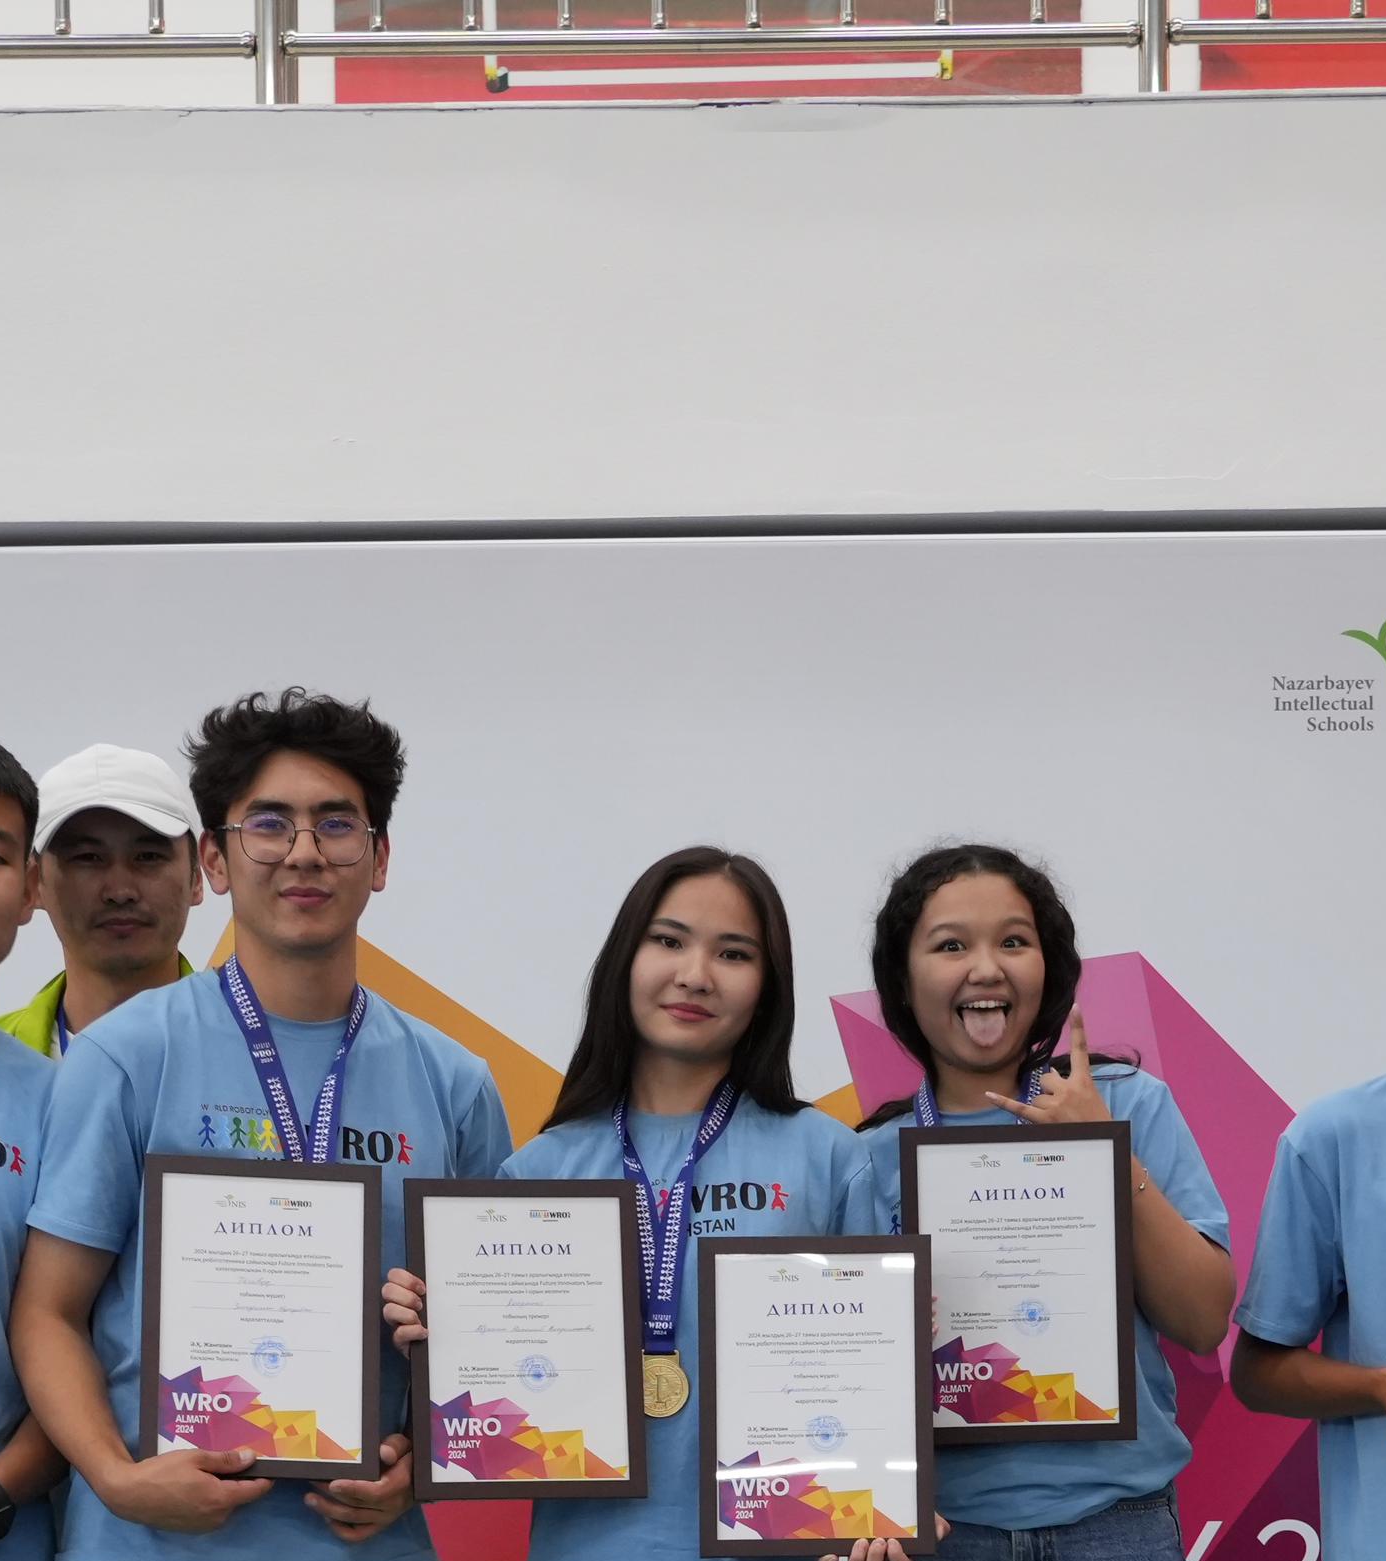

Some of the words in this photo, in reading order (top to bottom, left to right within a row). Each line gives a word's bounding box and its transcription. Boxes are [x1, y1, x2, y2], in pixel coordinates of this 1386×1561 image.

[1272, 675, 1374, 693] Nazarbayev
[1273, 696, 1374, 712] Intellectual
[1306, 716, 1374, 732] Schools
[969, 1187, 1065, 1203] ДИПЛОМ
[214, 1222, 313, 1237] ДИПЛОМ
[475, 1243, 572, 1257] ДИПЛОМ
[766, 1302, 864, 1317] ДИПЛОМ
[935, 1362, 993, 1381] WRO
[939, 1384, 973, 1394] ALMATY
[172, 1392, 232, 1412] WRO
[940, 1395, 958, 1404] 2024
[175, 1414, 210, 1424] ALMATY
[175, 1424, 194, 1434] 2024
[443, 1417, 502, 1437] WRO
[448, 1440, 481, 1449] ALMATY
[448, 1450, 466, 1459] 2024
[731, 1477, 789, 1497] WRO
[735, 1500, 769, 1509] ALMATY
[735, 1510, 754, 1519] 2024
